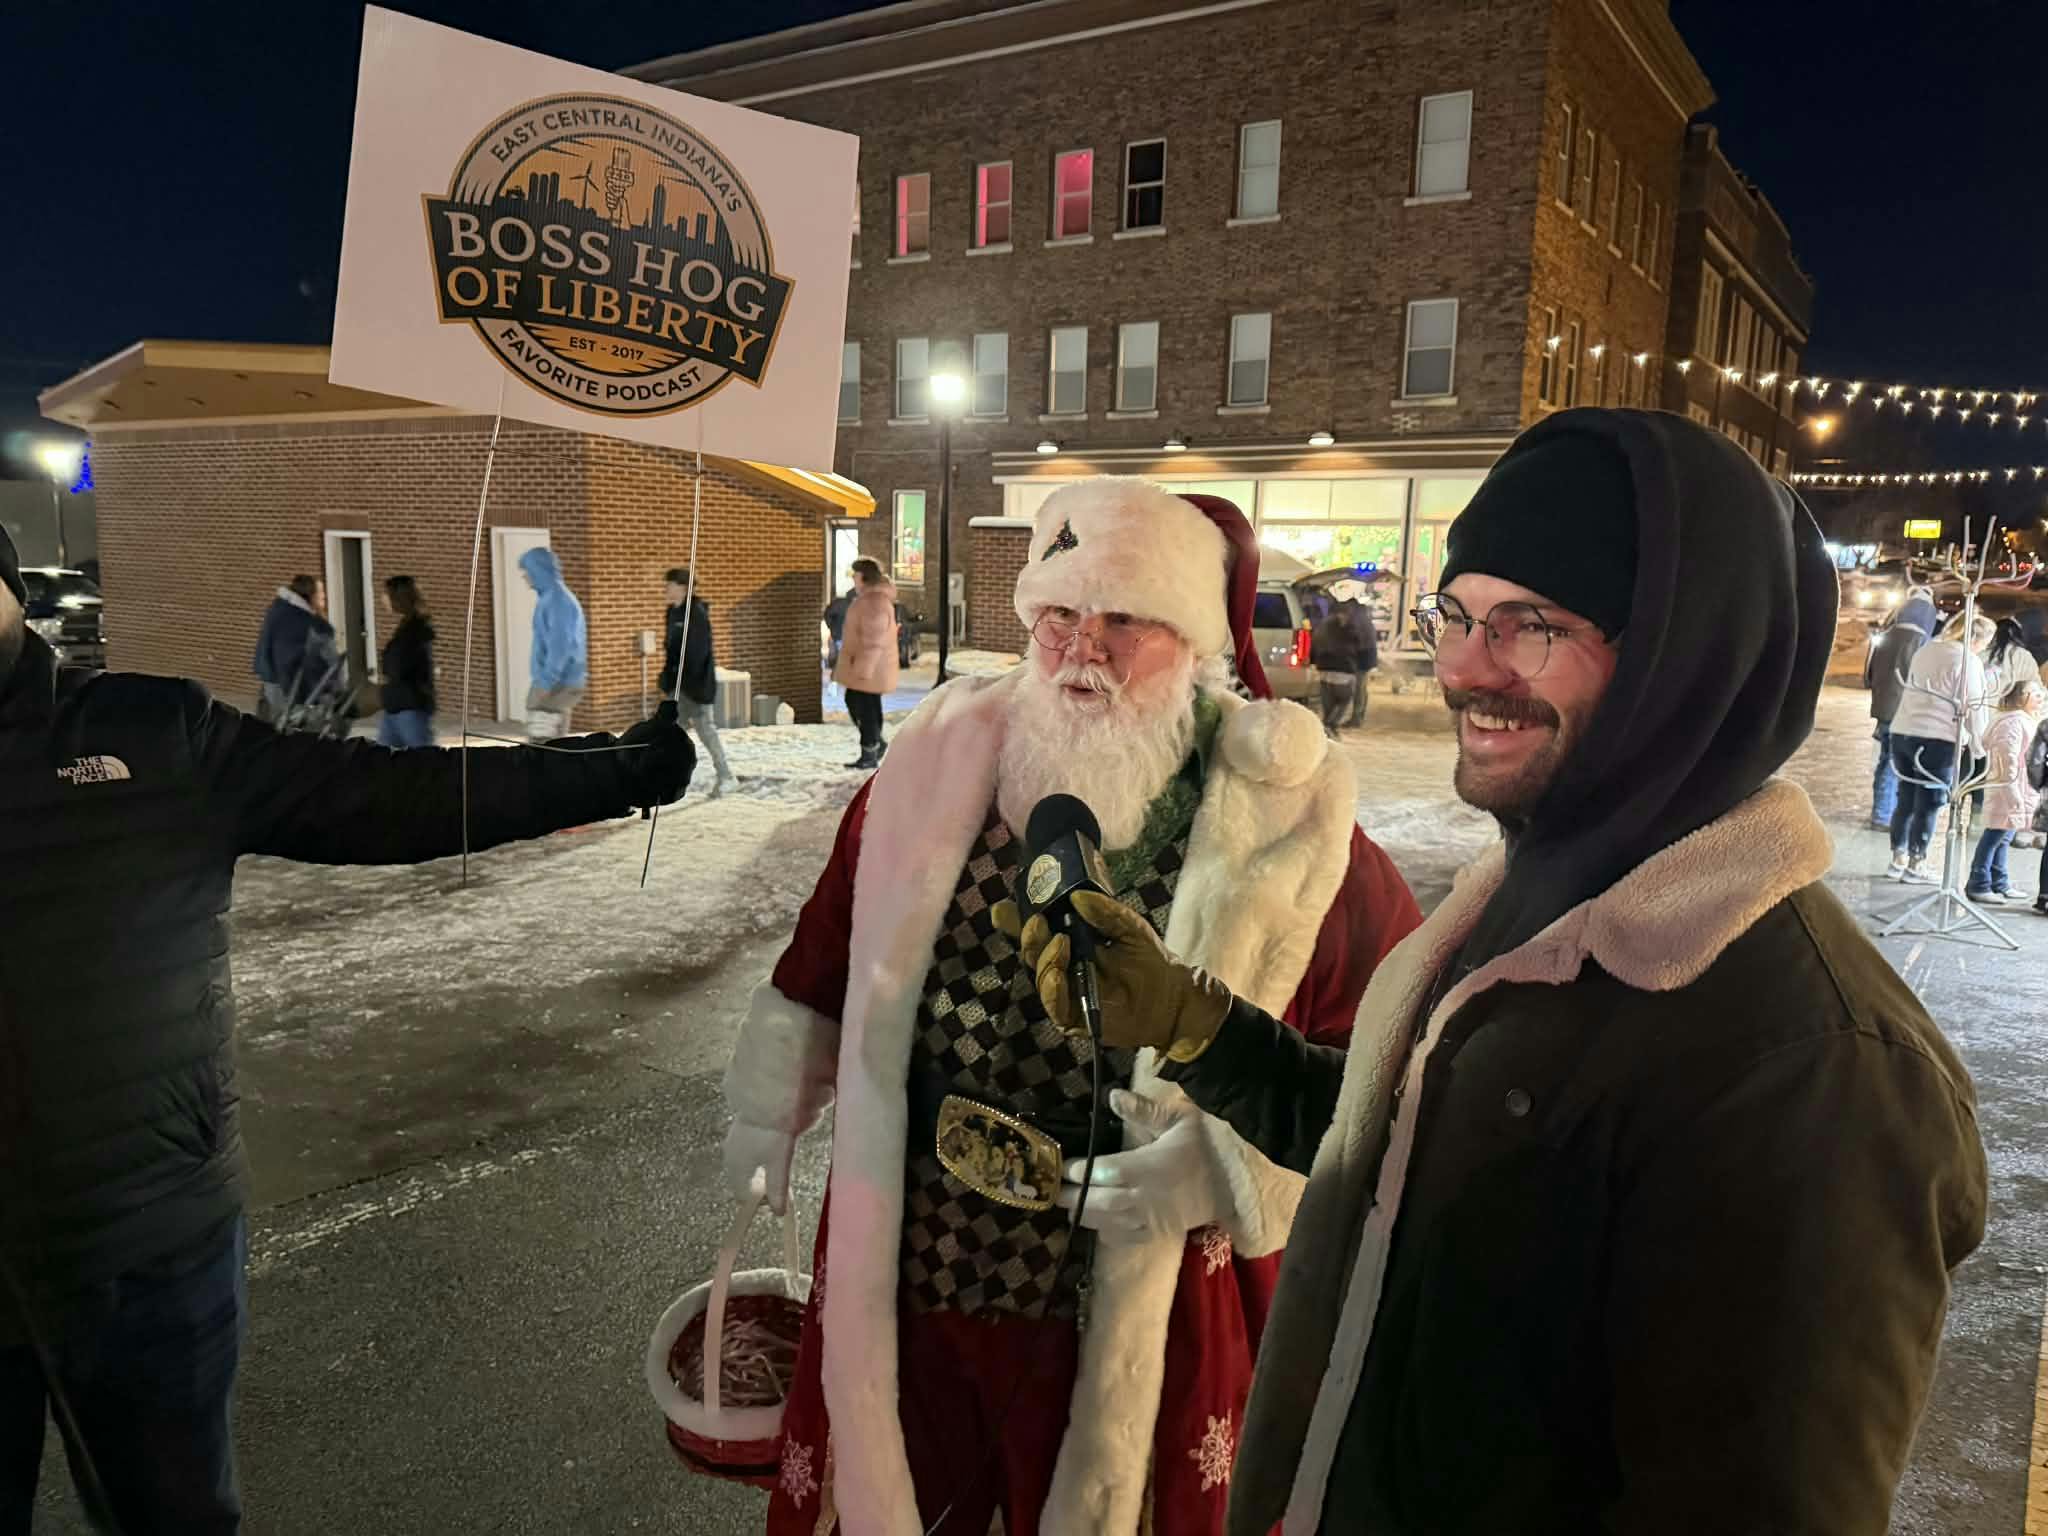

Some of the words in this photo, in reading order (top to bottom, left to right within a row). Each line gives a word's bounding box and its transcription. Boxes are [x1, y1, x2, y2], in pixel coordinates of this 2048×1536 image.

[490, 121, 540, 163] EAST
[543, 109, 646, 135] CENTRAL
[651, 124, 743, 213] INDIANA'S
[443, 211, 612, 276] BOSS
[628, 241, 767, 321] HOG
[447, 266, 521, 309] OF
[537, 274, 766, 365] LIBERTY
[500, 328, 600, 397] FAVORITE
[605, 365, 703, 401] PODCAST
[569, 336, 597, 353] EST
[611, 345, 644, 361] 2017
[56, 762, 105, 779] NORTH
[73, 755, 102, 767] THE
[73, 773, 107, 785] FACE
